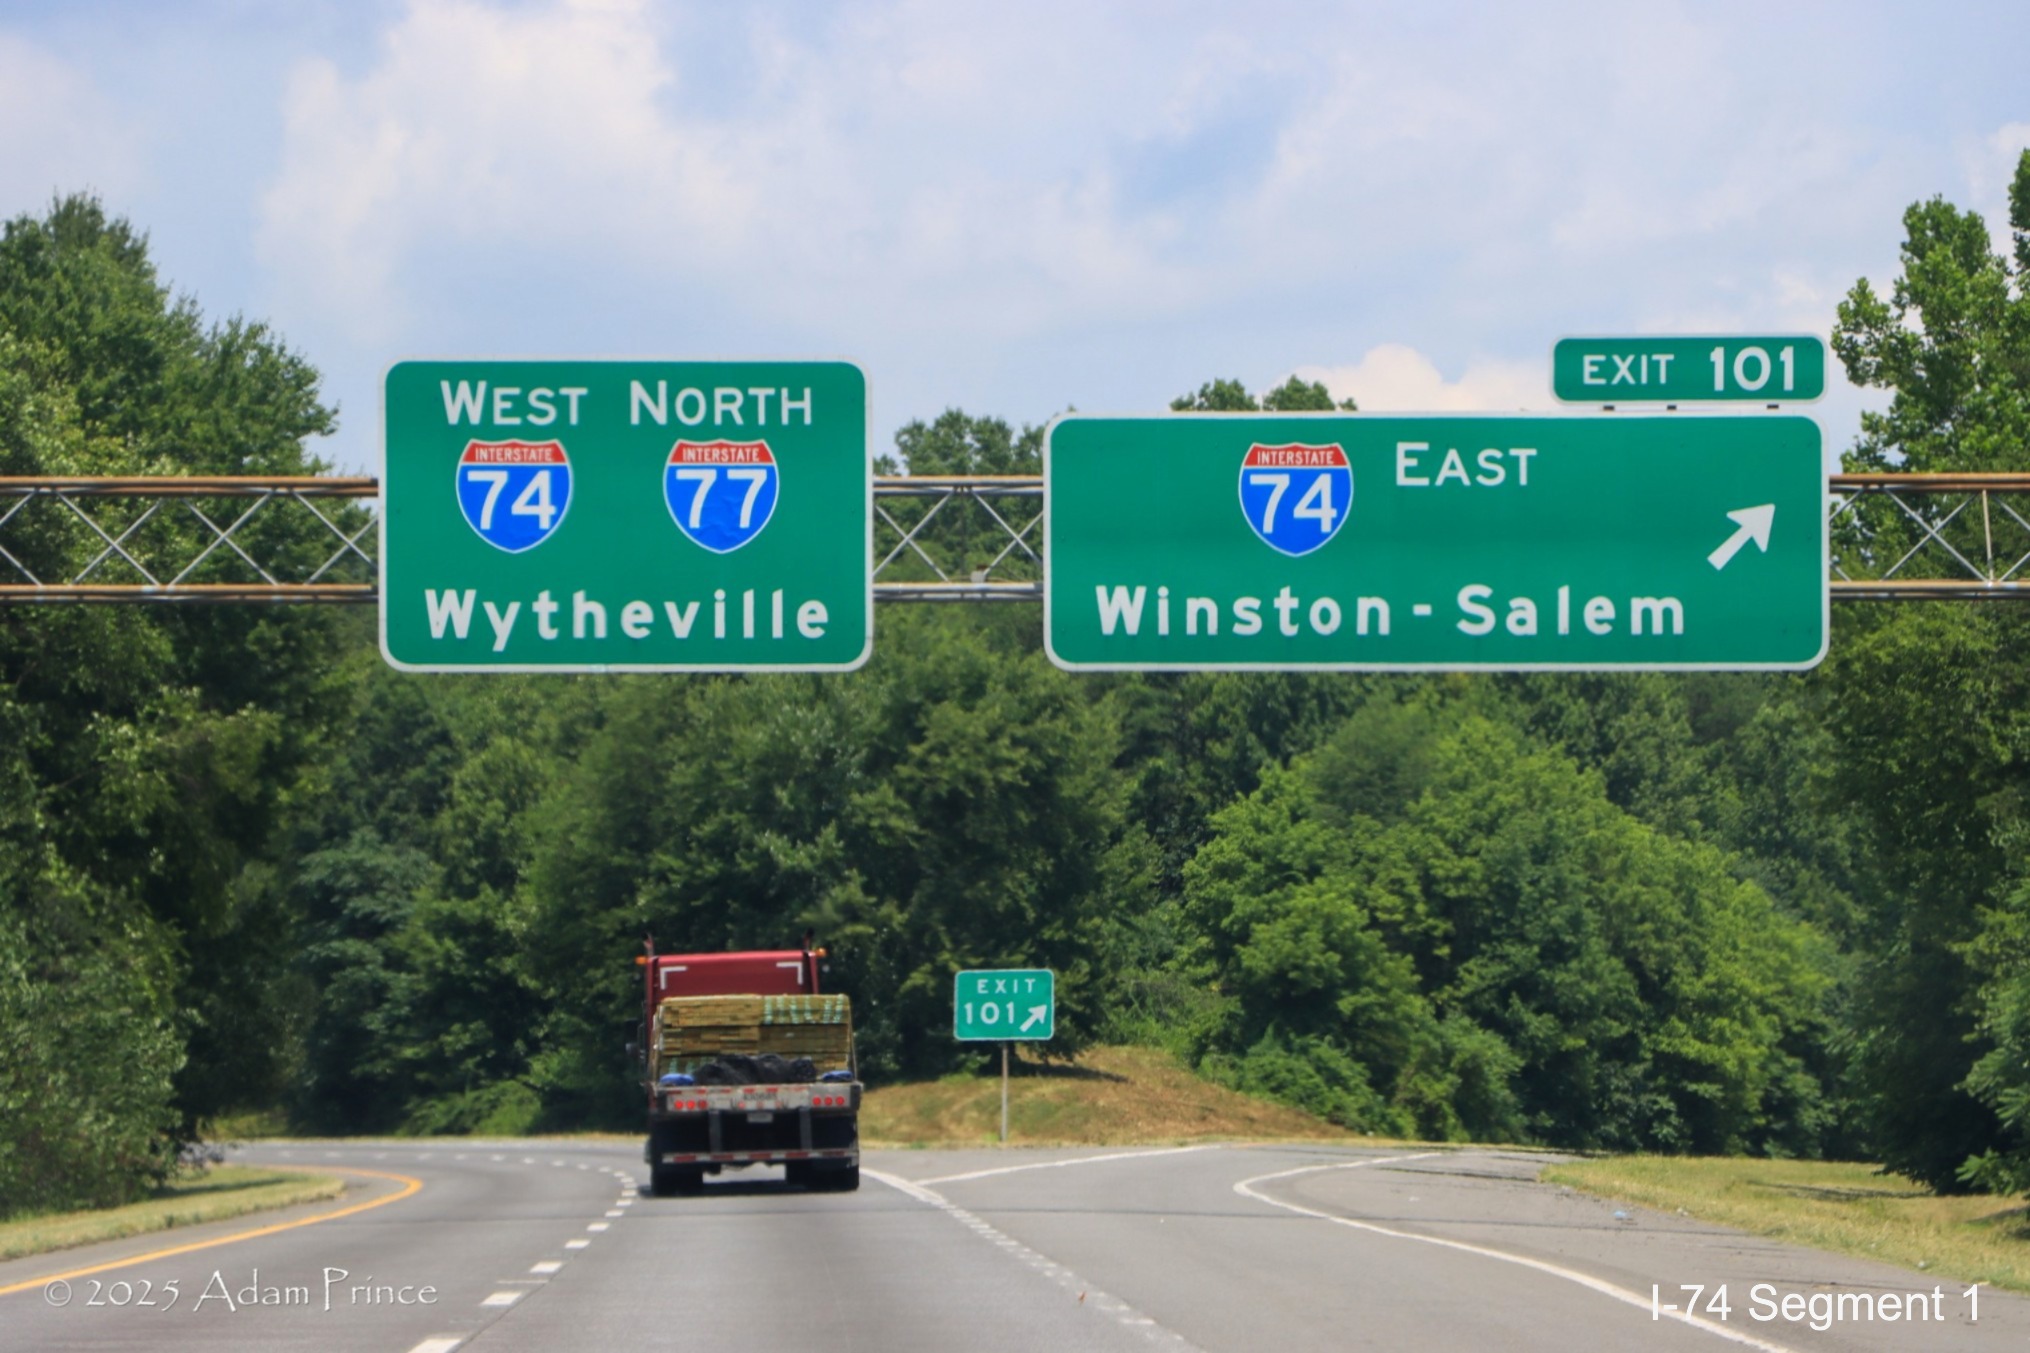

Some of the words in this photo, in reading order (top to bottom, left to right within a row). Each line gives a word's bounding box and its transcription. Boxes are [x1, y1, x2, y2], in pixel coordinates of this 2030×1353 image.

[1581, 354, 1675, 385] EXIT
[1709, 346, 1795, 391] 101
[440, 380, 588, 425] WEST
[630, 380, 813, 425] NORTH
[475, 447, 554, 462] INTERSTATE
[682, 447, 760, 462] INTERSTATE
[1256, 450, 1335, 465] INTERSTATE
[1395, 442, 1538, 486] EAST
[467, 470, 557, 531] 74
[675, 468, 768, 529] 77
[1248, 474, 1338, 534] 74
[424, 589, 829, 652] Wytheville
[977, 978, 1036, 994] EXIT
[964, 1002, 1014, 1024] 101
